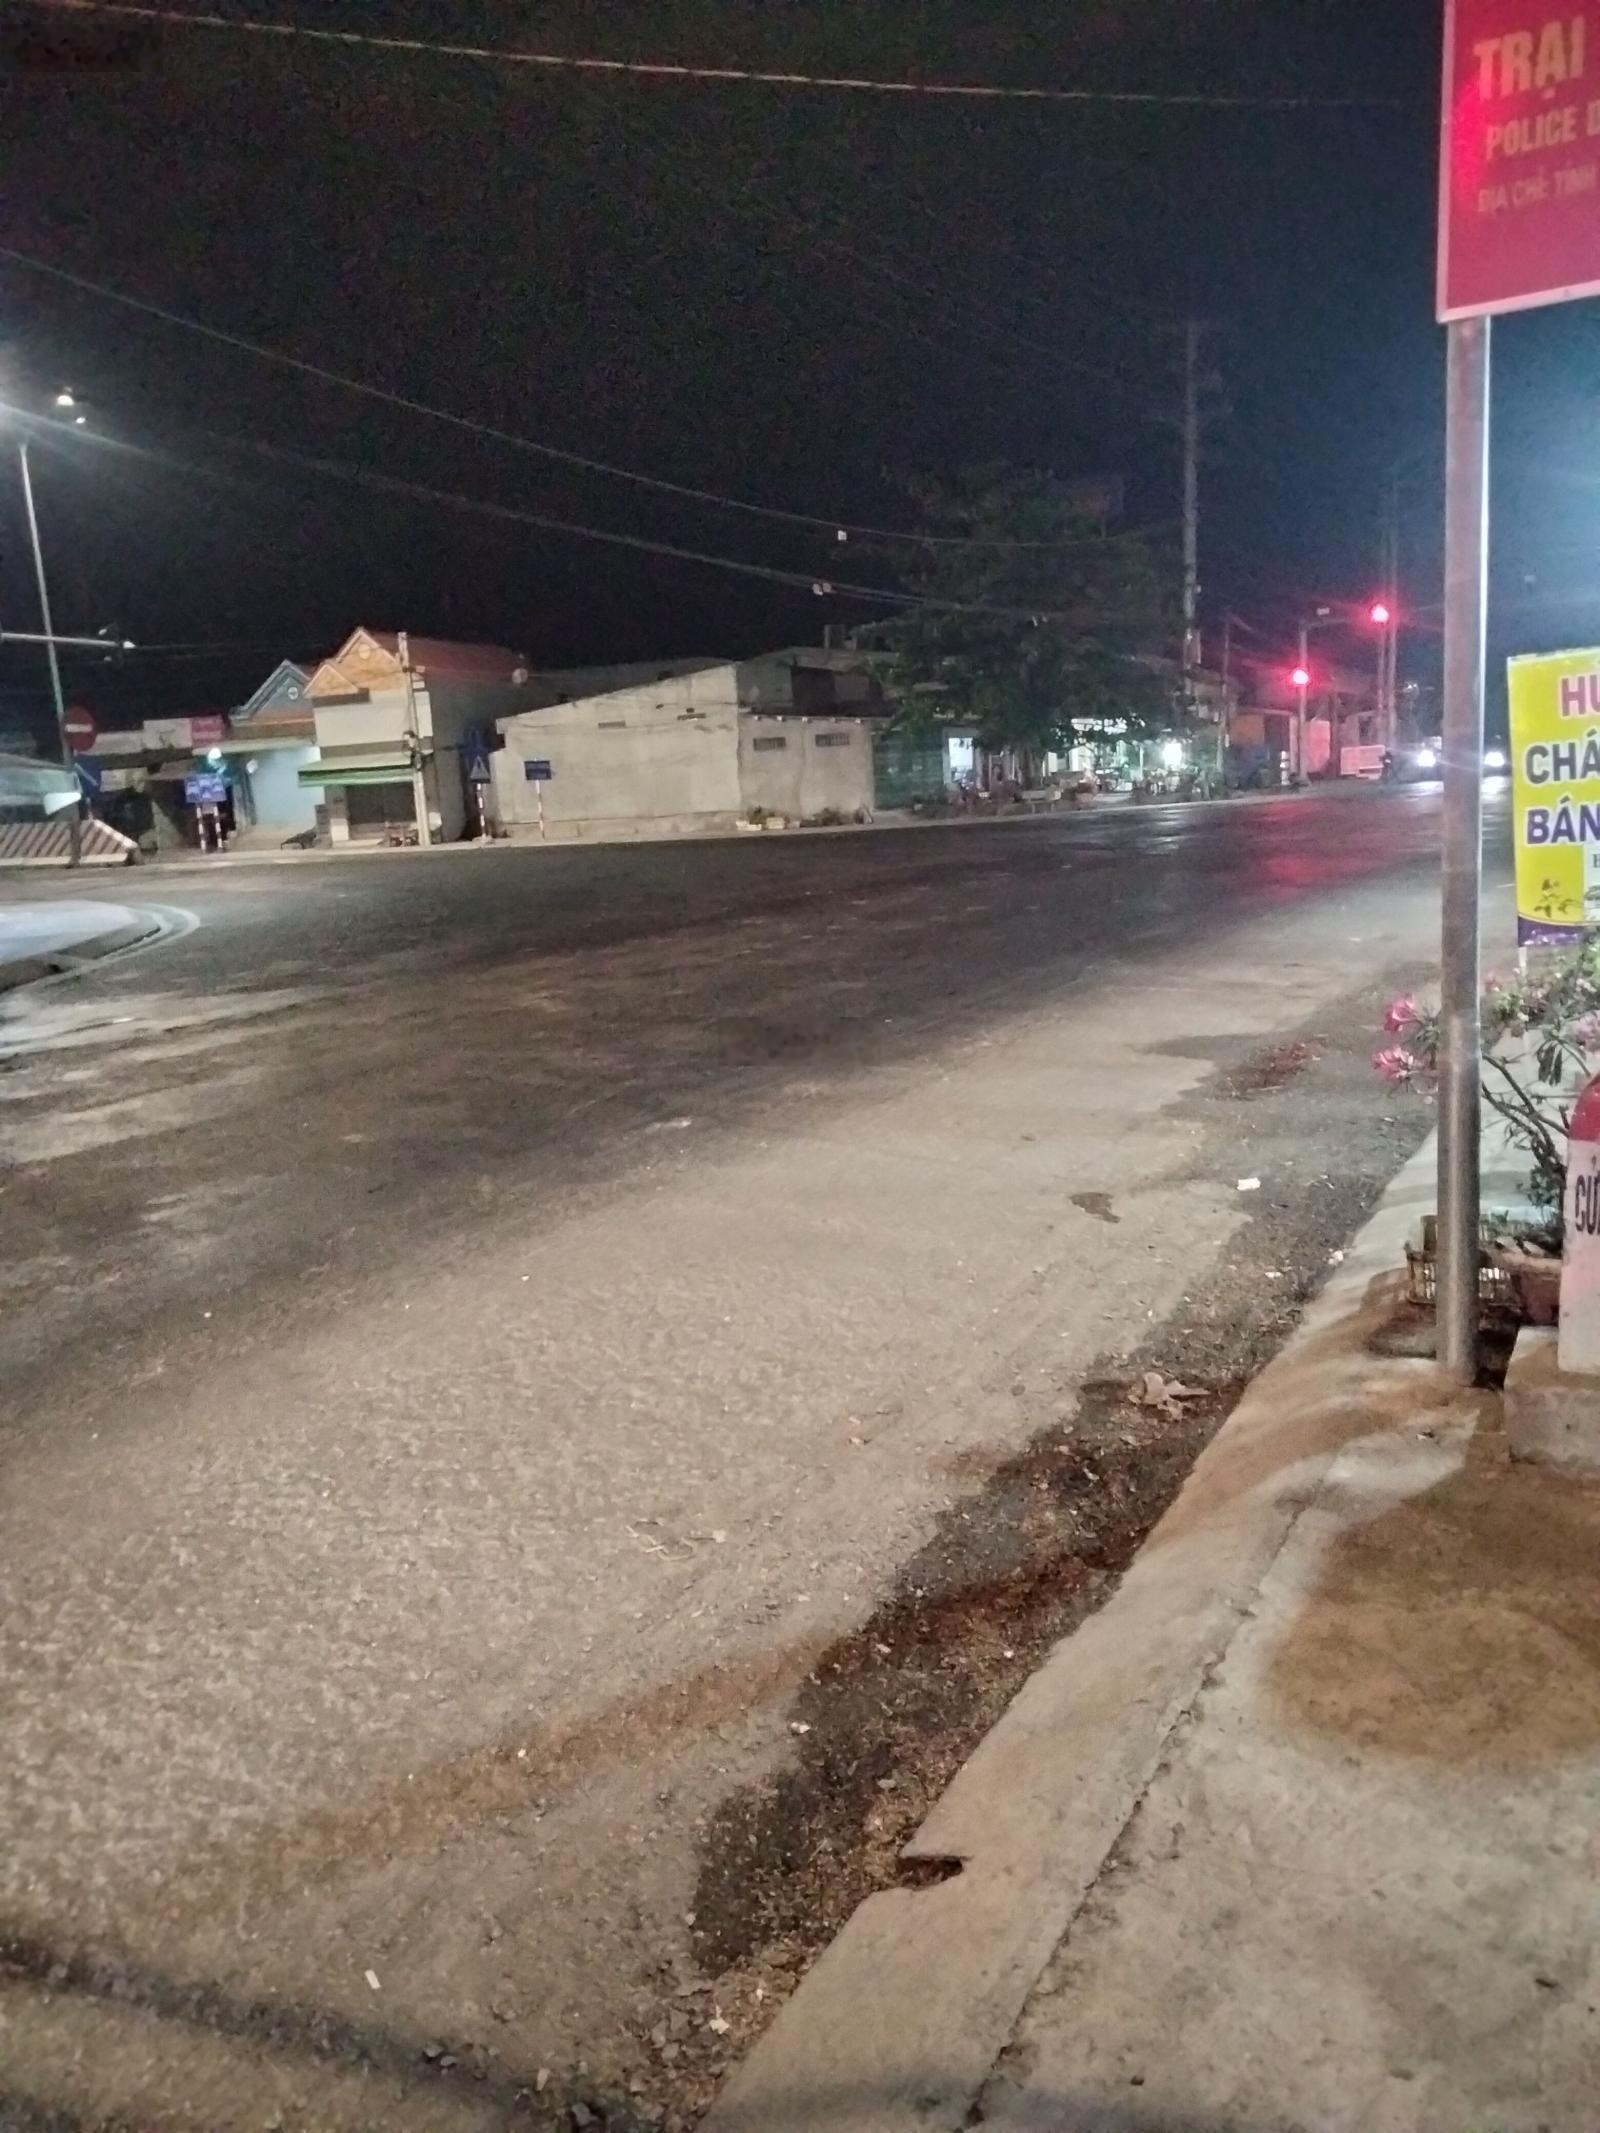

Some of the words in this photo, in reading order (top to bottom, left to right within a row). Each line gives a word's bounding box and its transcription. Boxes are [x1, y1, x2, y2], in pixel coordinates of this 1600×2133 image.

[1473, 15, 1585, 101] TRẠI
[1485, 105, 1577, 161] POLICE
[1527, 796, 1600, 845] BÁN
